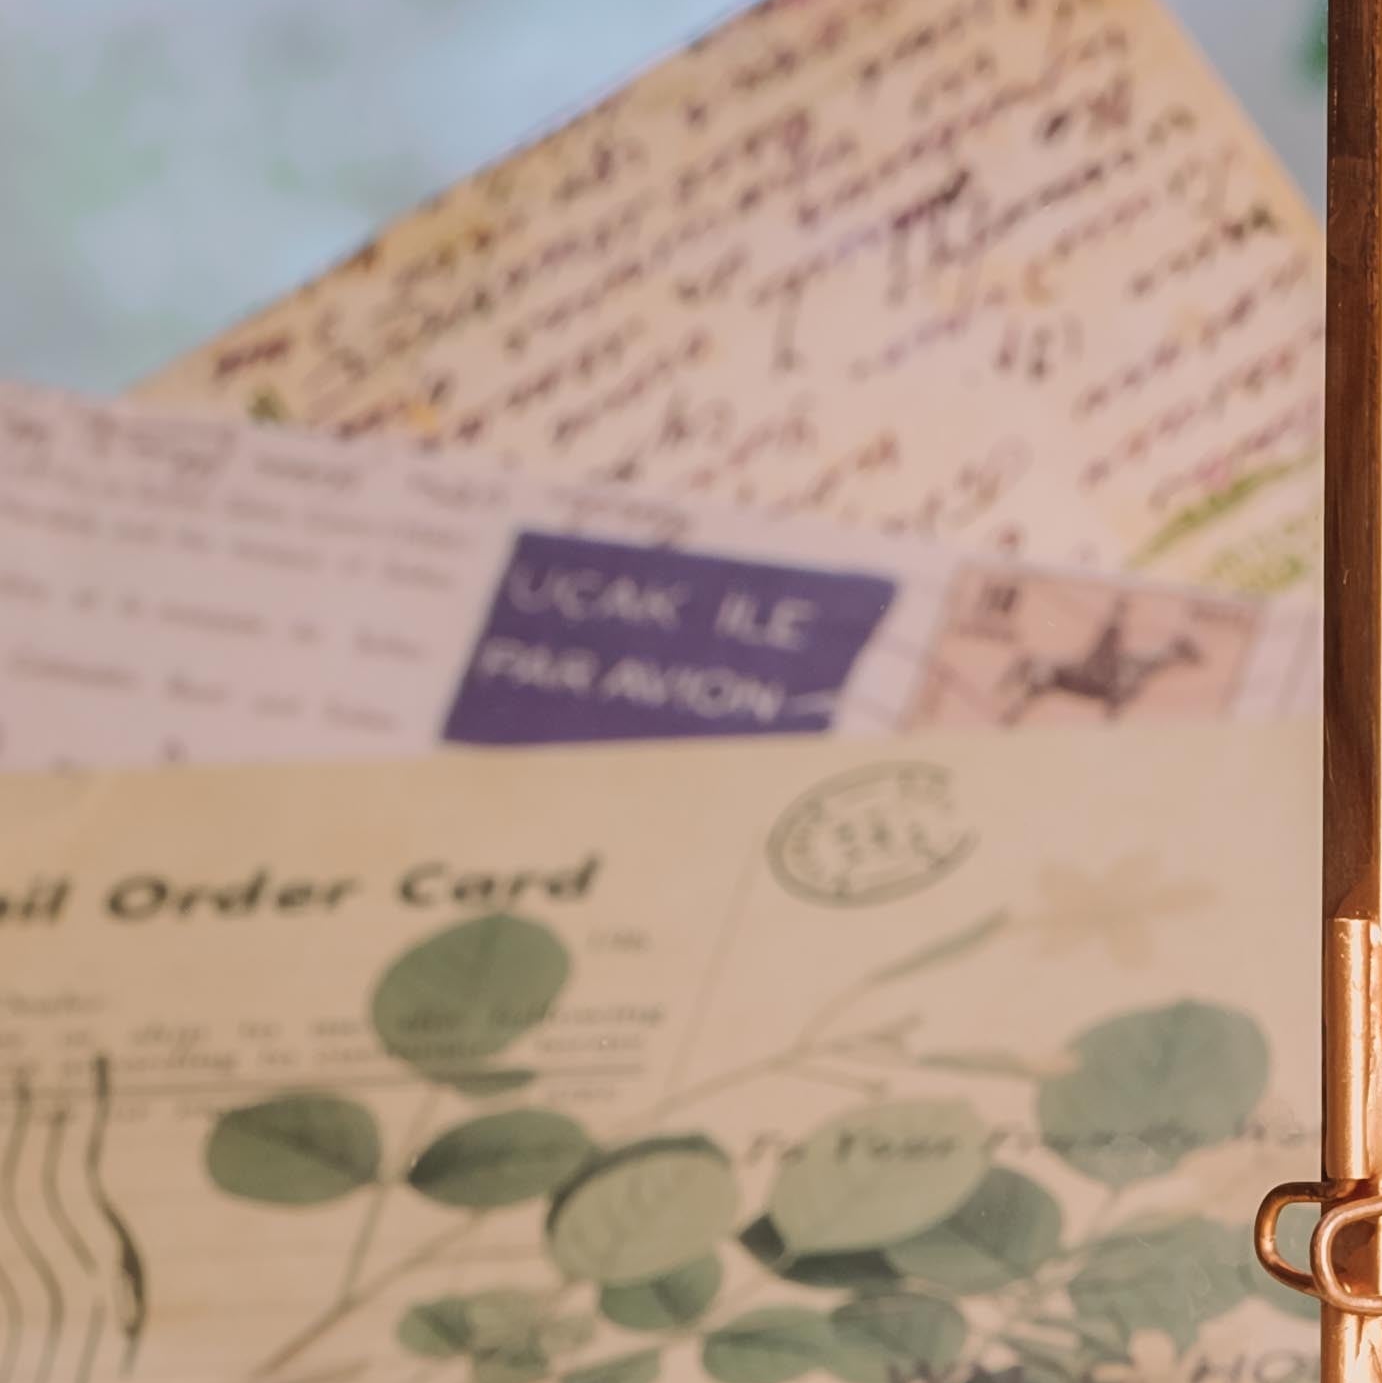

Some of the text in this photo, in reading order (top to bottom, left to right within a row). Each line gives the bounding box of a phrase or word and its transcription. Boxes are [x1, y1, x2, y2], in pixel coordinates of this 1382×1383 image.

[601, 657, 786, 724] AVION
[104, 865, 362, 922] Order
[394, 851, 604, 910] Card
